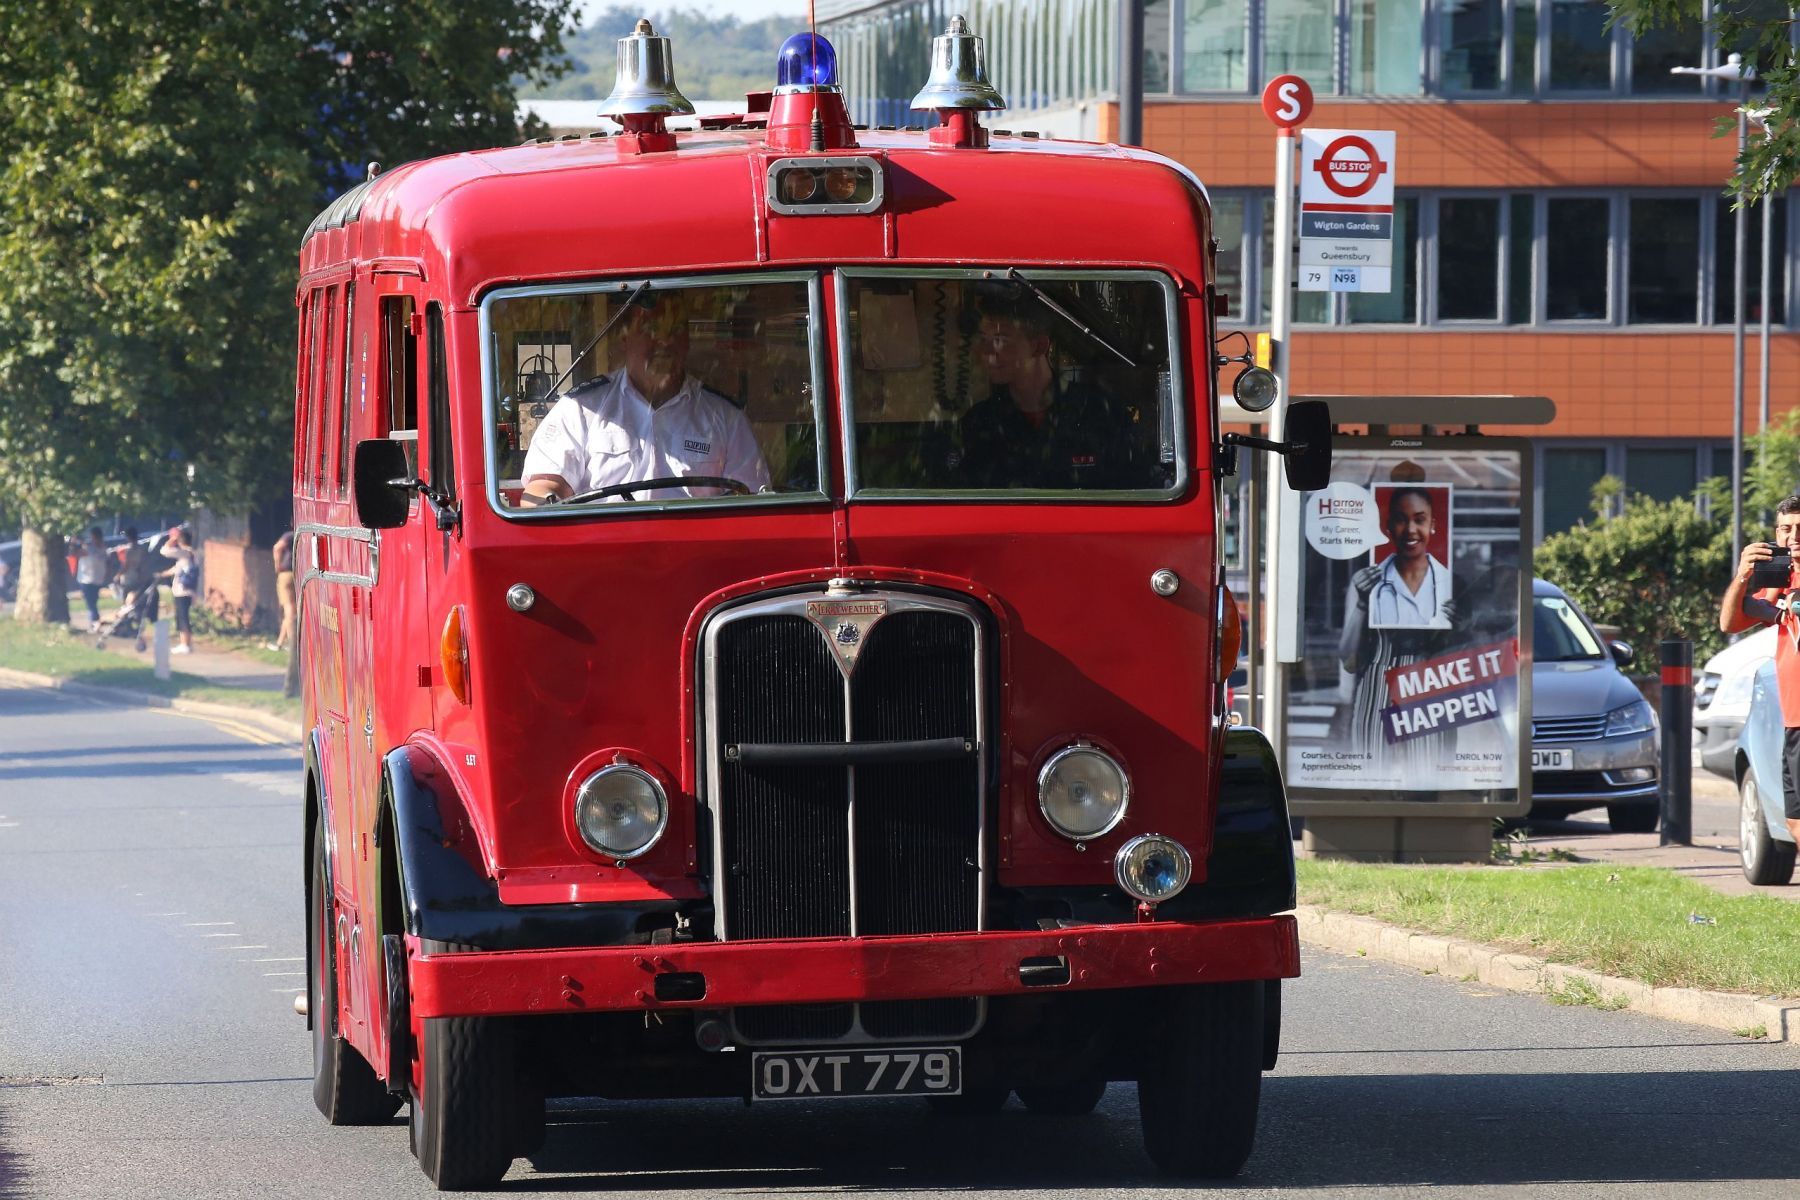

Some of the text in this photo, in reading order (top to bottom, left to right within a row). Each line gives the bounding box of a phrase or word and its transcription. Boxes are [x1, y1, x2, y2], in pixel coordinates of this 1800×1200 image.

[1275, 82, 1300, 121] S
[1329, 161, 1372, 171] BUS STOP
[1314, 221, 1380, 231] Wigton Gardens
[1321, 252, 1371, 261] Queensbury
[1308, 273, 1356, 283] 79 N98
[1319, 498, 1364, 515] Harrow
[1322, 526, 1333, 534] My
[1397, 649, 1501, 699] MAKE IT
[1391, 688, 1498, 737] HAPPEN
[1301, 752, 1373, 760] Courses, Careers &
[1455, 753, 1503, 761] ENROL NOW
[1301, 763, 1362, 771] Apprenticeships
[763, 1053, 950, 1094] OXT 779
